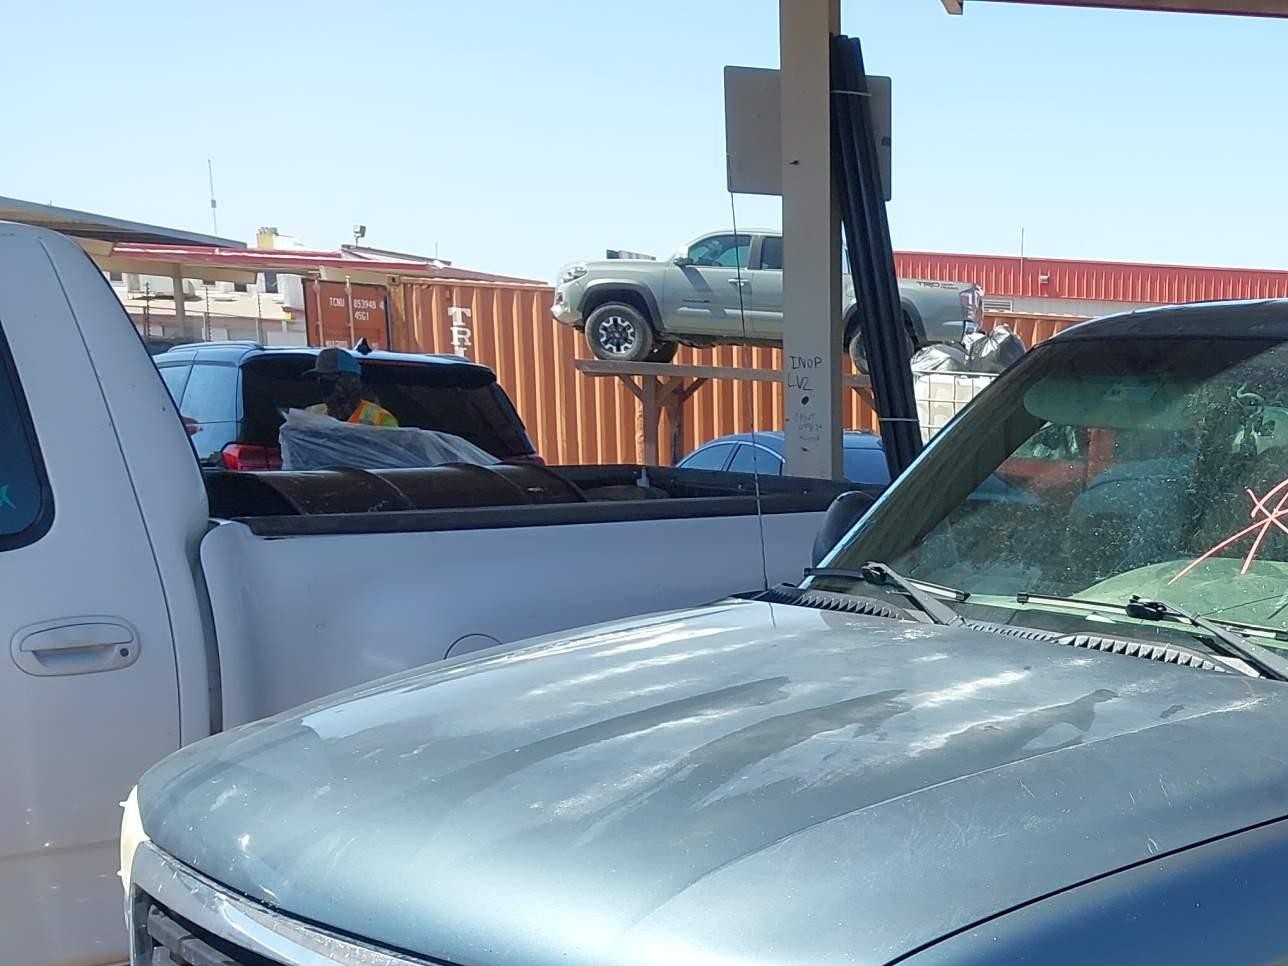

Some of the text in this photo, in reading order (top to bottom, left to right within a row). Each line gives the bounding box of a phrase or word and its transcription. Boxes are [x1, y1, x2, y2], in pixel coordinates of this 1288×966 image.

[329, 297, 345, 308] TCNU
[353, 299, 377, 310] 853948
[354, 311, 369, 321] 45G1
[790, 356, 822, 369] INOP
